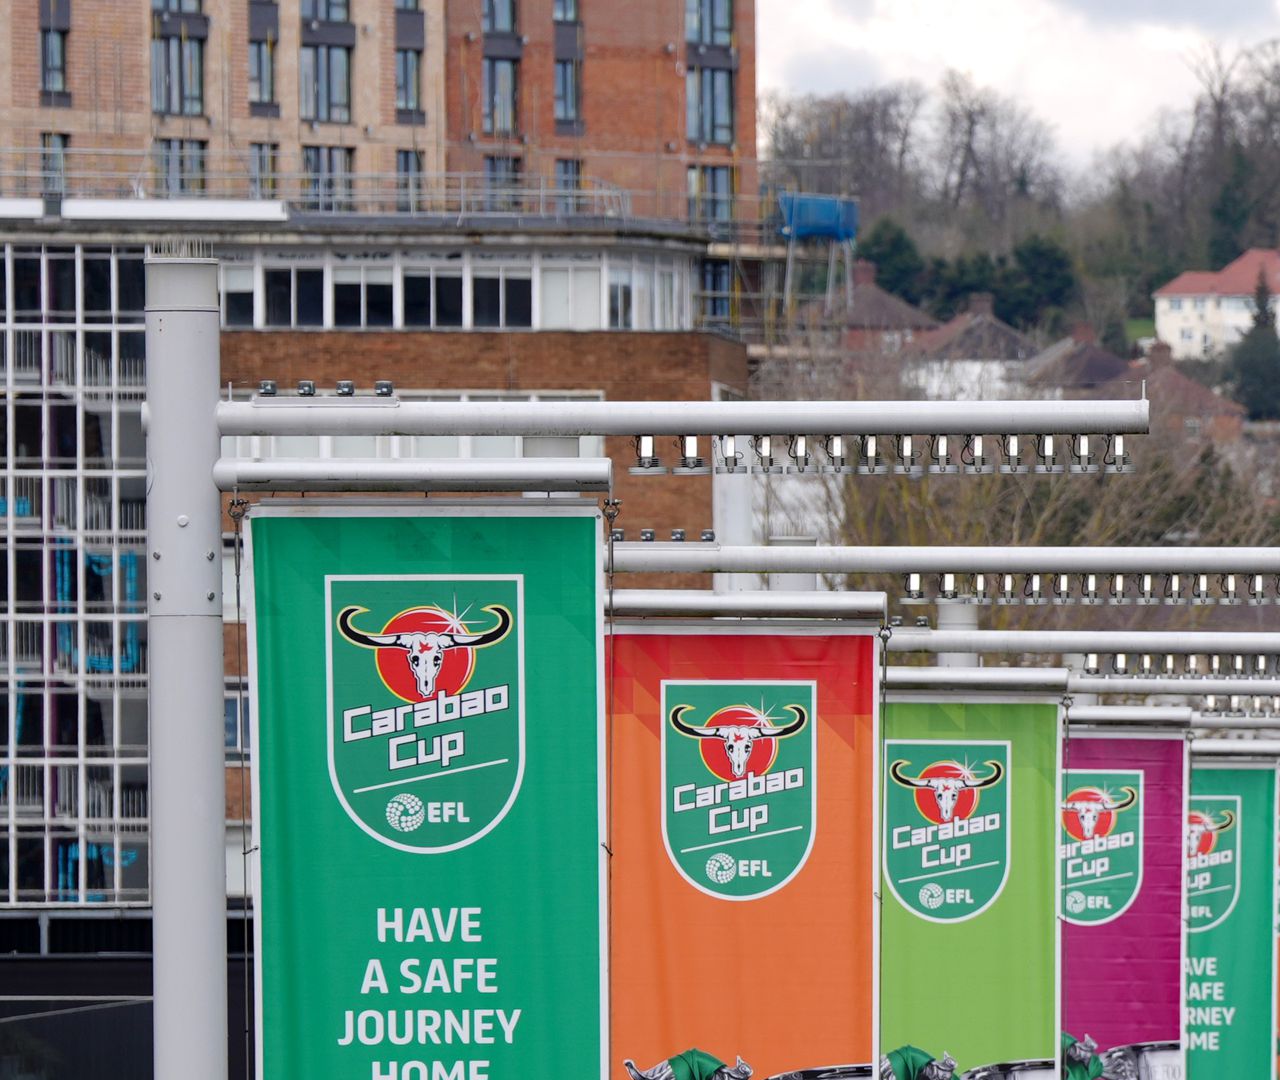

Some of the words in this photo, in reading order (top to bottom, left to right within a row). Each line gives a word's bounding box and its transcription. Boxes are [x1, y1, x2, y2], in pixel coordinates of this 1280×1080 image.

[342, 684, 509, 743] Carabao
[387, 729, 465, 770] Cup
[673, 767, 804, 814] Carabao
[427, 801, 470, 824] EFL
[708, 801, 769, 836] Cup
[892, 813, 1000, 851] Carabao
[921, 843, 971, 869] Cup
[1061, 832, 1134, 860] arabao
[738, 860, 772, 878] EFL
[1067, 857, 1109, 879] Cup
[945, 889, 974, 904] EFL
[1087, 896, 1112, 910] EFL
[376, 907, 482, 942] HAVE
[1191, 906, 1213, 918] EFL
[361, 959, 389, 994] A
[400, 957, 498, 994] SAFE
[1184, 957, 1217, 976] AVE
[1184, 982, 1225, 1001] AFE
[338, 1009, 522, 1046] JOURNEY
[1184, 1007, 1236, 1026] RNEY
